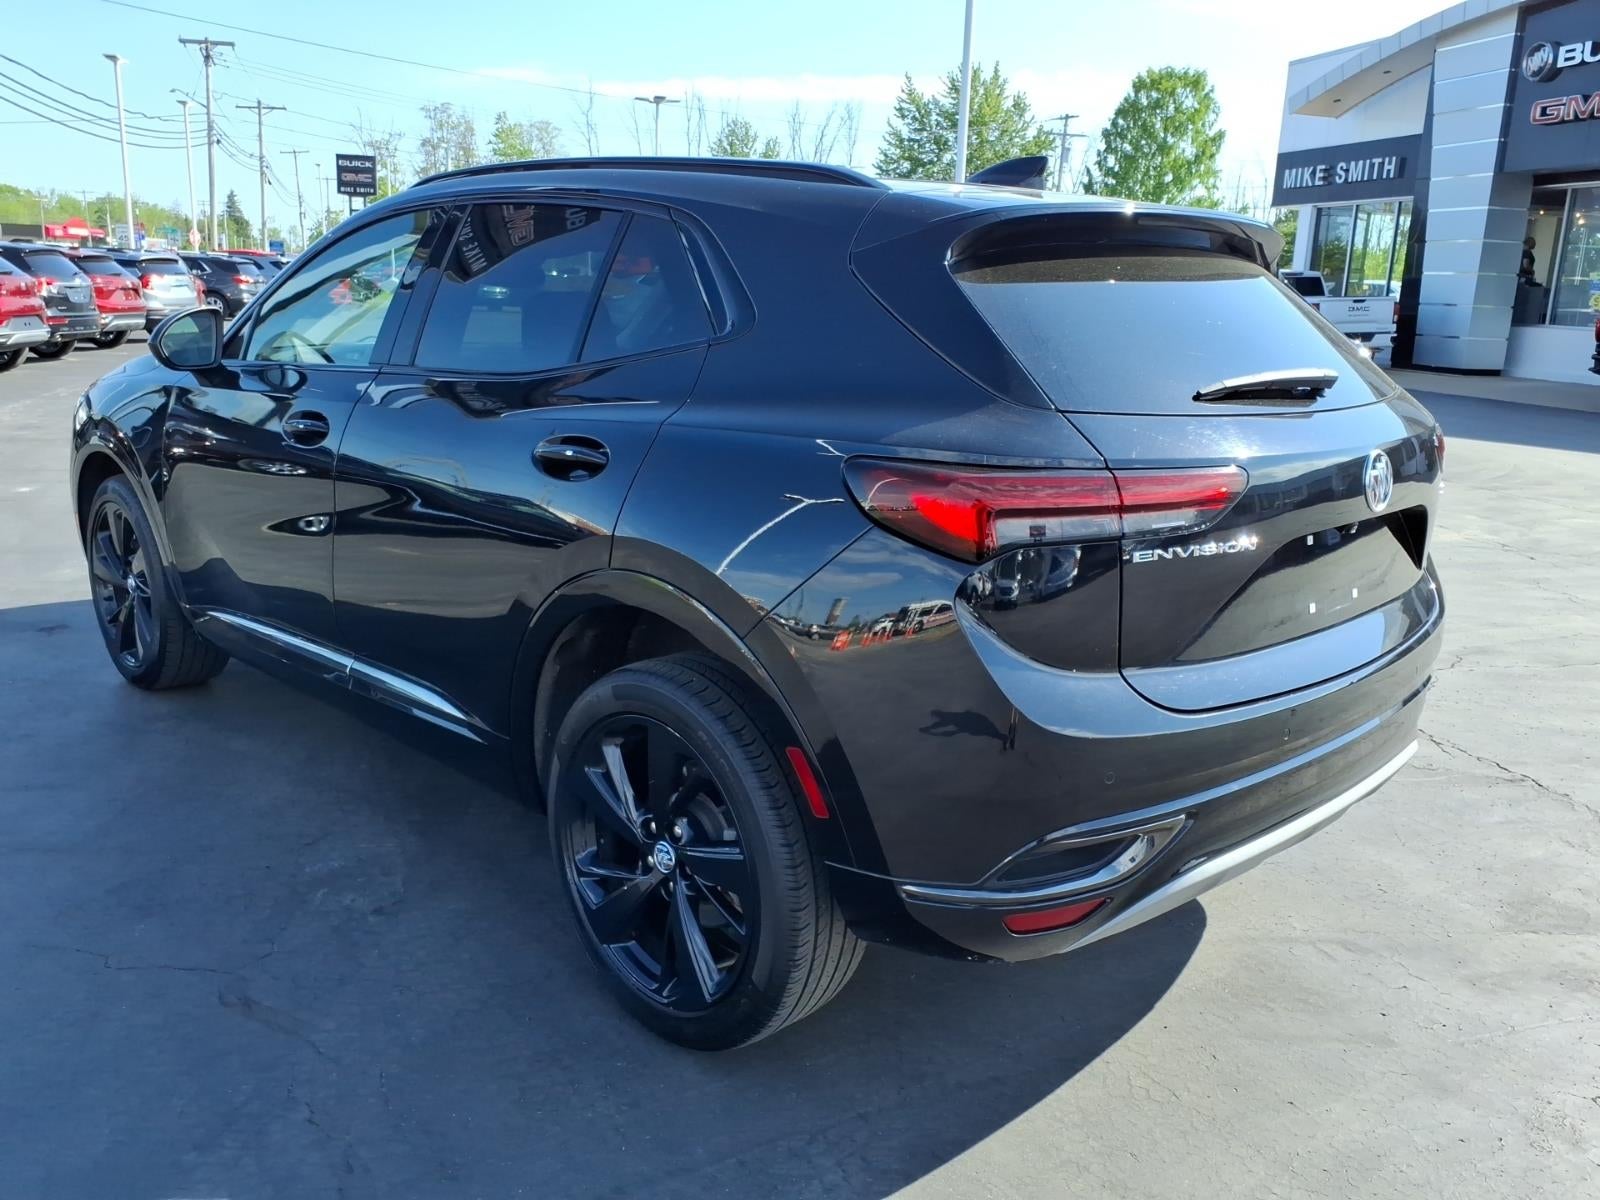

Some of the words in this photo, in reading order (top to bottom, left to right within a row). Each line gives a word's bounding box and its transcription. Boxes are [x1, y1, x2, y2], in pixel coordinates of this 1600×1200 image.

[1557, 40, 1600, 69] BU
[338, 159, 374, 168] BUICK
[341, 172, 373, 182] GMC
[1282, 165, 1327, 189] MIKE
[1335, 156, 1397, 184] SMITH
[1132, 536, 1259, 563] ENVISION
